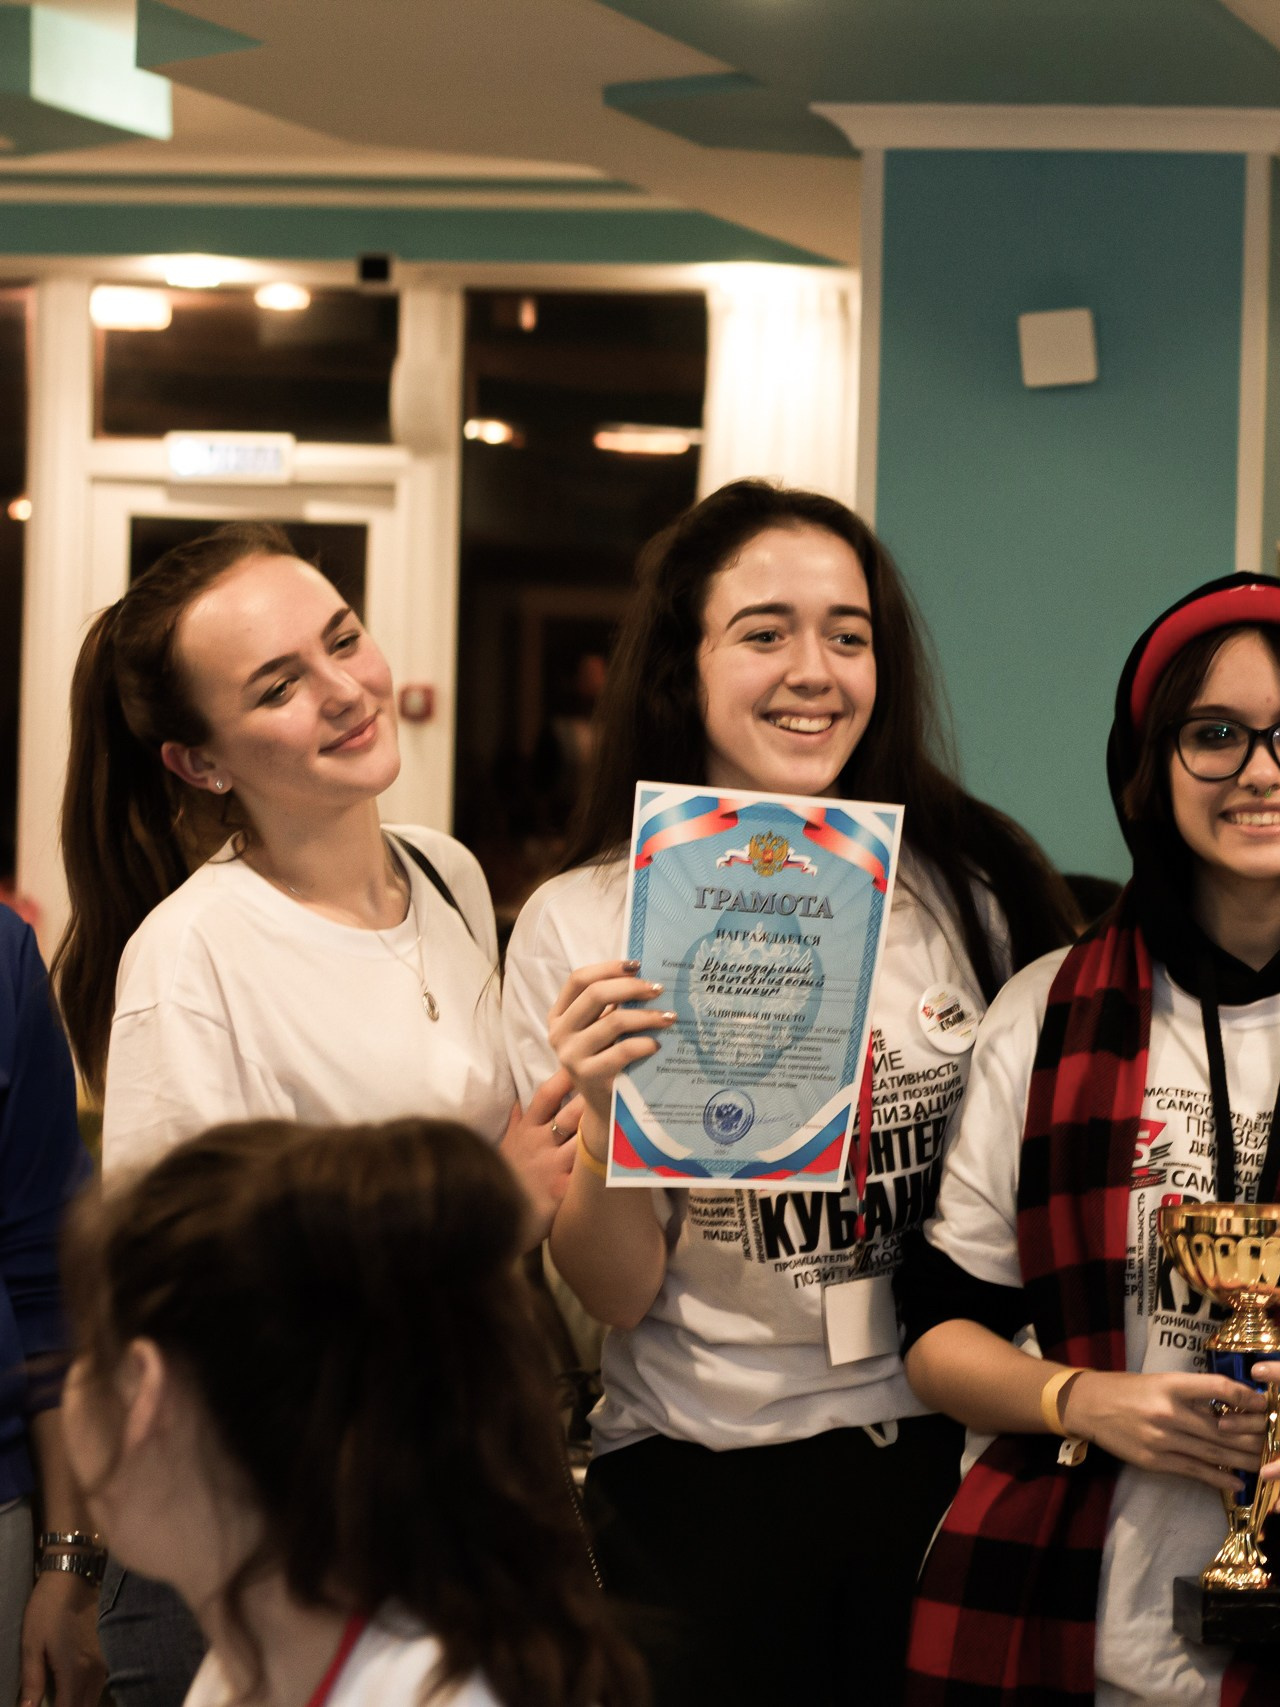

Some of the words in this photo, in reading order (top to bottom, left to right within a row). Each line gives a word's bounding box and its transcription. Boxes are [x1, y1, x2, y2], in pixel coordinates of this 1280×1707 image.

[694, 887, 834, 919] ГРАМОТА
[716, 929, 821, 946] НАГРАЖДАЕТСЯ
[872, 1061, 959, 1091] ЕАТИВНОСТЬ
[903, 1075, 961, 1101] ПОЗИЦИЯ
